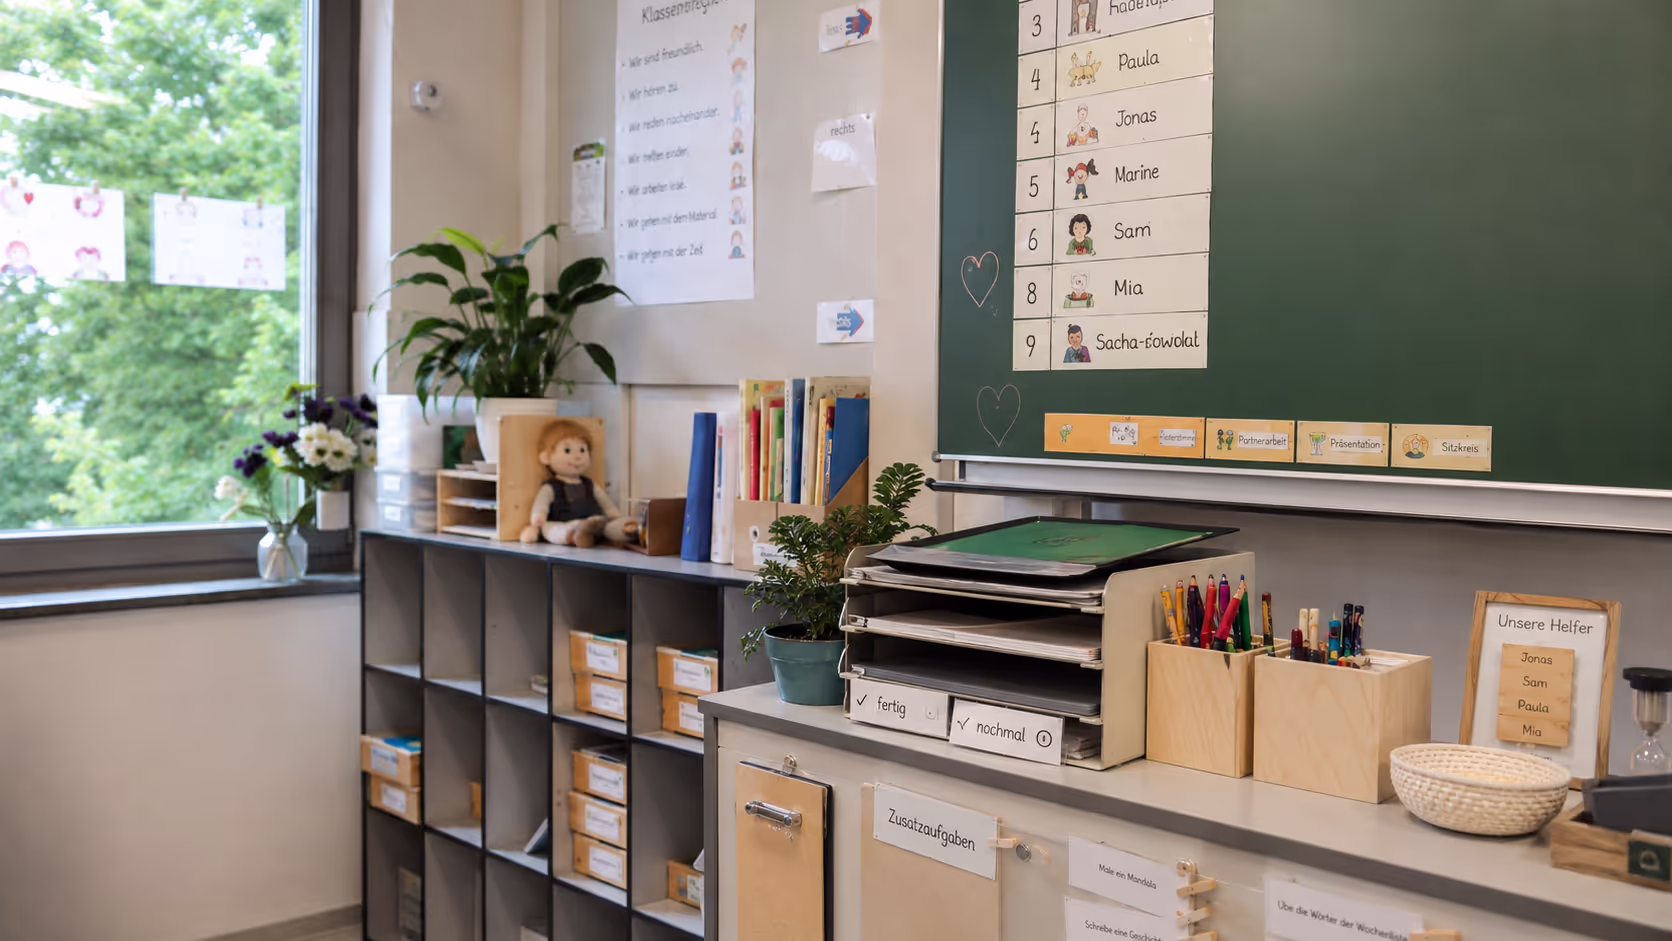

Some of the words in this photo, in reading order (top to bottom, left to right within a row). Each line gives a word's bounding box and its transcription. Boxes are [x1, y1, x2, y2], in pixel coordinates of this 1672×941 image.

[1031, 14, 1042, 37] 3
[628, 56, 641, 68] Wir
[1118, 50, 1160, 71] Paula
[1031, 68, 1041, 91] 4
[628, 88, 641, 100] Wir
[1115, 109, 1157, 128] Jonas
[831, 121, 856, 136] rechts
[1115, 164, 1160, 184] Marine
[1028, 175, 1039, 198] 5
[627, 218, 639, 228] Wir
[673, 210, 687, 224] dem
[1028, 228, 1038, 251] 6
[1114, 222, 1151, 240] Sam
[675, 244, 687, 256] der
[1026, 282, 1037, 304] 8
[1114, 279, 1144, 296] Mia
[1026, 335, 1036, 357] 9
[1238, 433, 1287, 446] Partnerarbeit
[1330, 438, 1381, 449] Präsentation
[1441, 442, 1479, 453] Sitzkreis
[1498, 614, 1545, 631] Unsere
[1550, 618, 1593, 635] Helfer
[1520, 652, 1553, 666] Jonas
[1522, 676, 1548, 689] Sam
[877, 696, 906, 719] fertig
[1518, 699, 1550, 714] Paula
[976, 721, 1026, 743] nochmal
[1522, 724, 1542, 737] Mia
[888, 808, 976, 851] Zusatzaufgaben
[1116, 871, 1127, 880] ein
[1127, 873, 1157, 890] Mandala
[1340, 917, 1354, 928] der
[1114, 928, 1128, 938] eine
